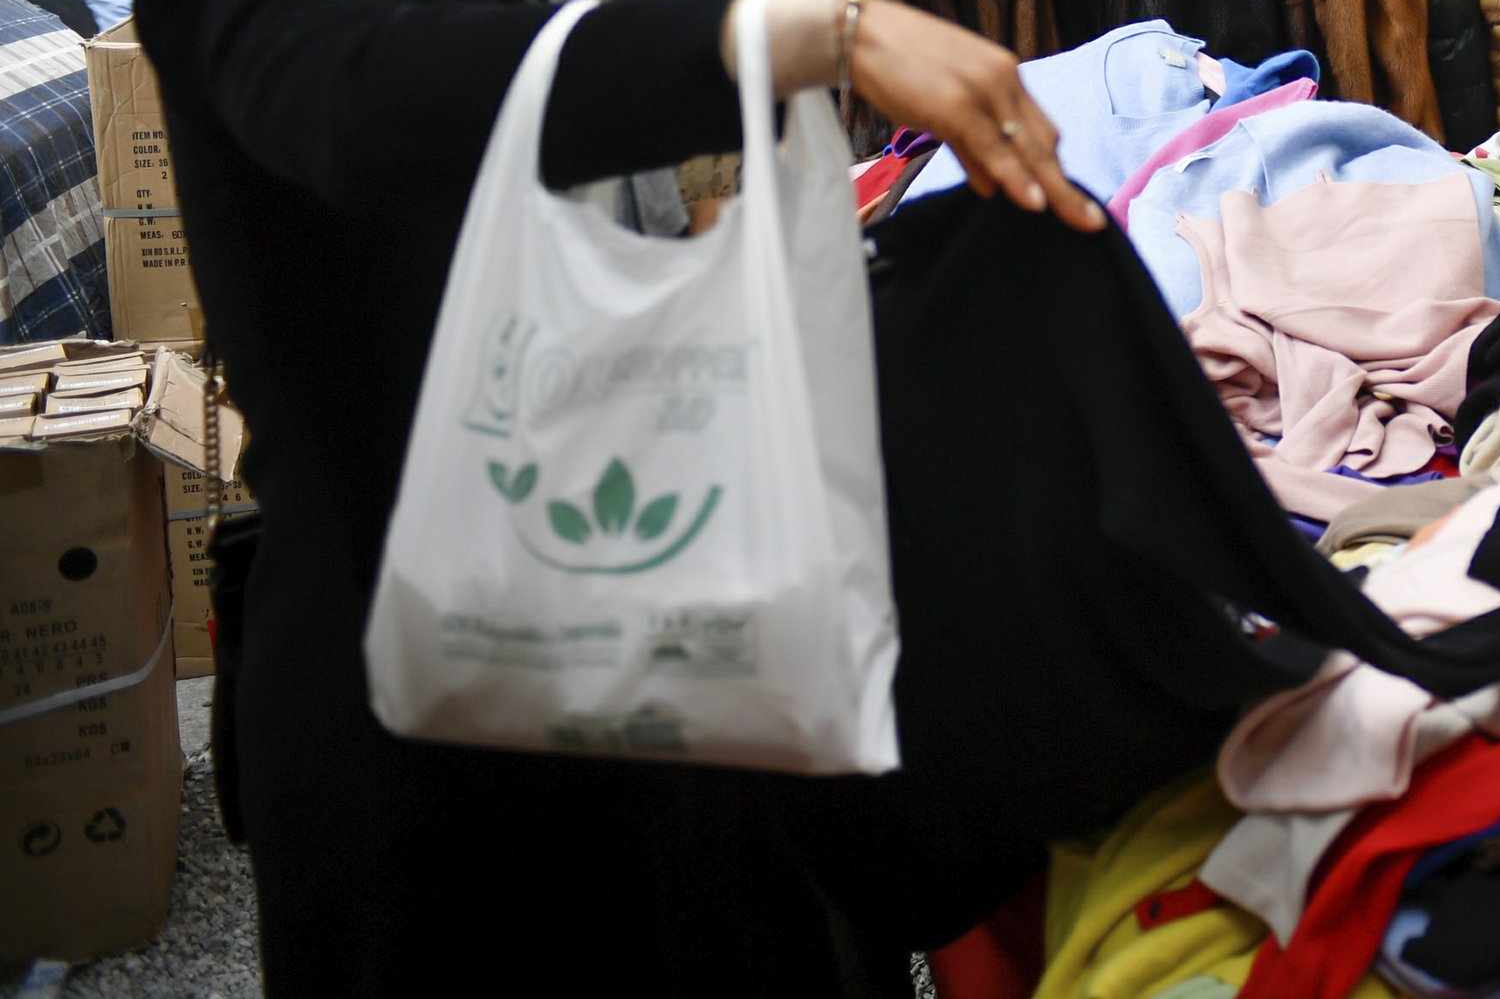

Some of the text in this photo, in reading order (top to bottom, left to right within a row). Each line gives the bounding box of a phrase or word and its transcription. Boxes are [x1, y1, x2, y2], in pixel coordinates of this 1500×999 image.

[132, 131, 151, 141] ITEM
[134, 159, 155, 168] SIZE:
[161, 171, 168, 180] 2
[143, 259, 163, 268] MADE
[165, 258, 173, 267] IN
[25, 619, 78, 639] NERO
[78, 696, 108, 712] KGS
[78, 721, 108, 737] KGS
[110, 738, 132, 755] CM
